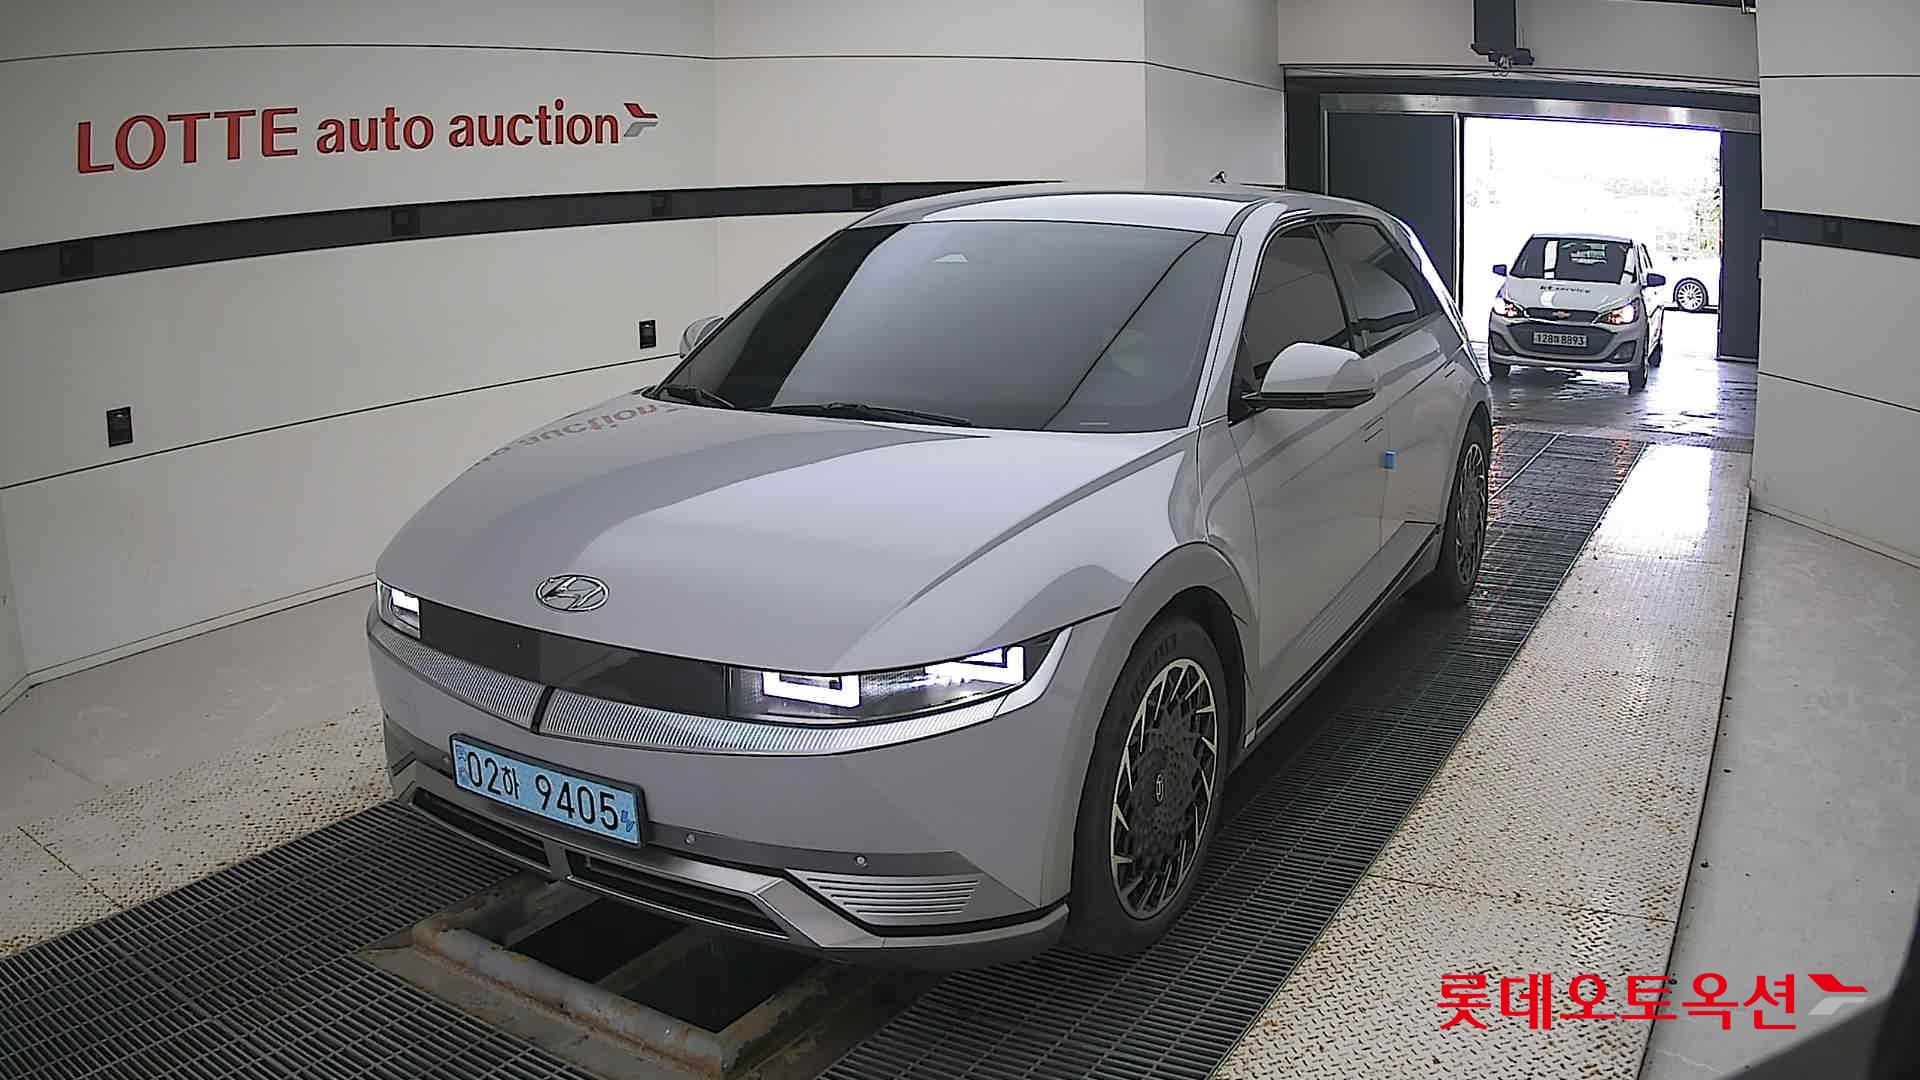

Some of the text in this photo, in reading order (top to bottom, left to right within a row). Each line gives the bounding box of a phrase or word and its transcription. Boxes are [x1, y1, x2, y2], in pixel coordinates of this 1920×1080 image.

[77, 99, 620, 174] LOTTE auto auction
[467, 751, 520, 800] 02하
[535, 774, 619, 831] 9405
